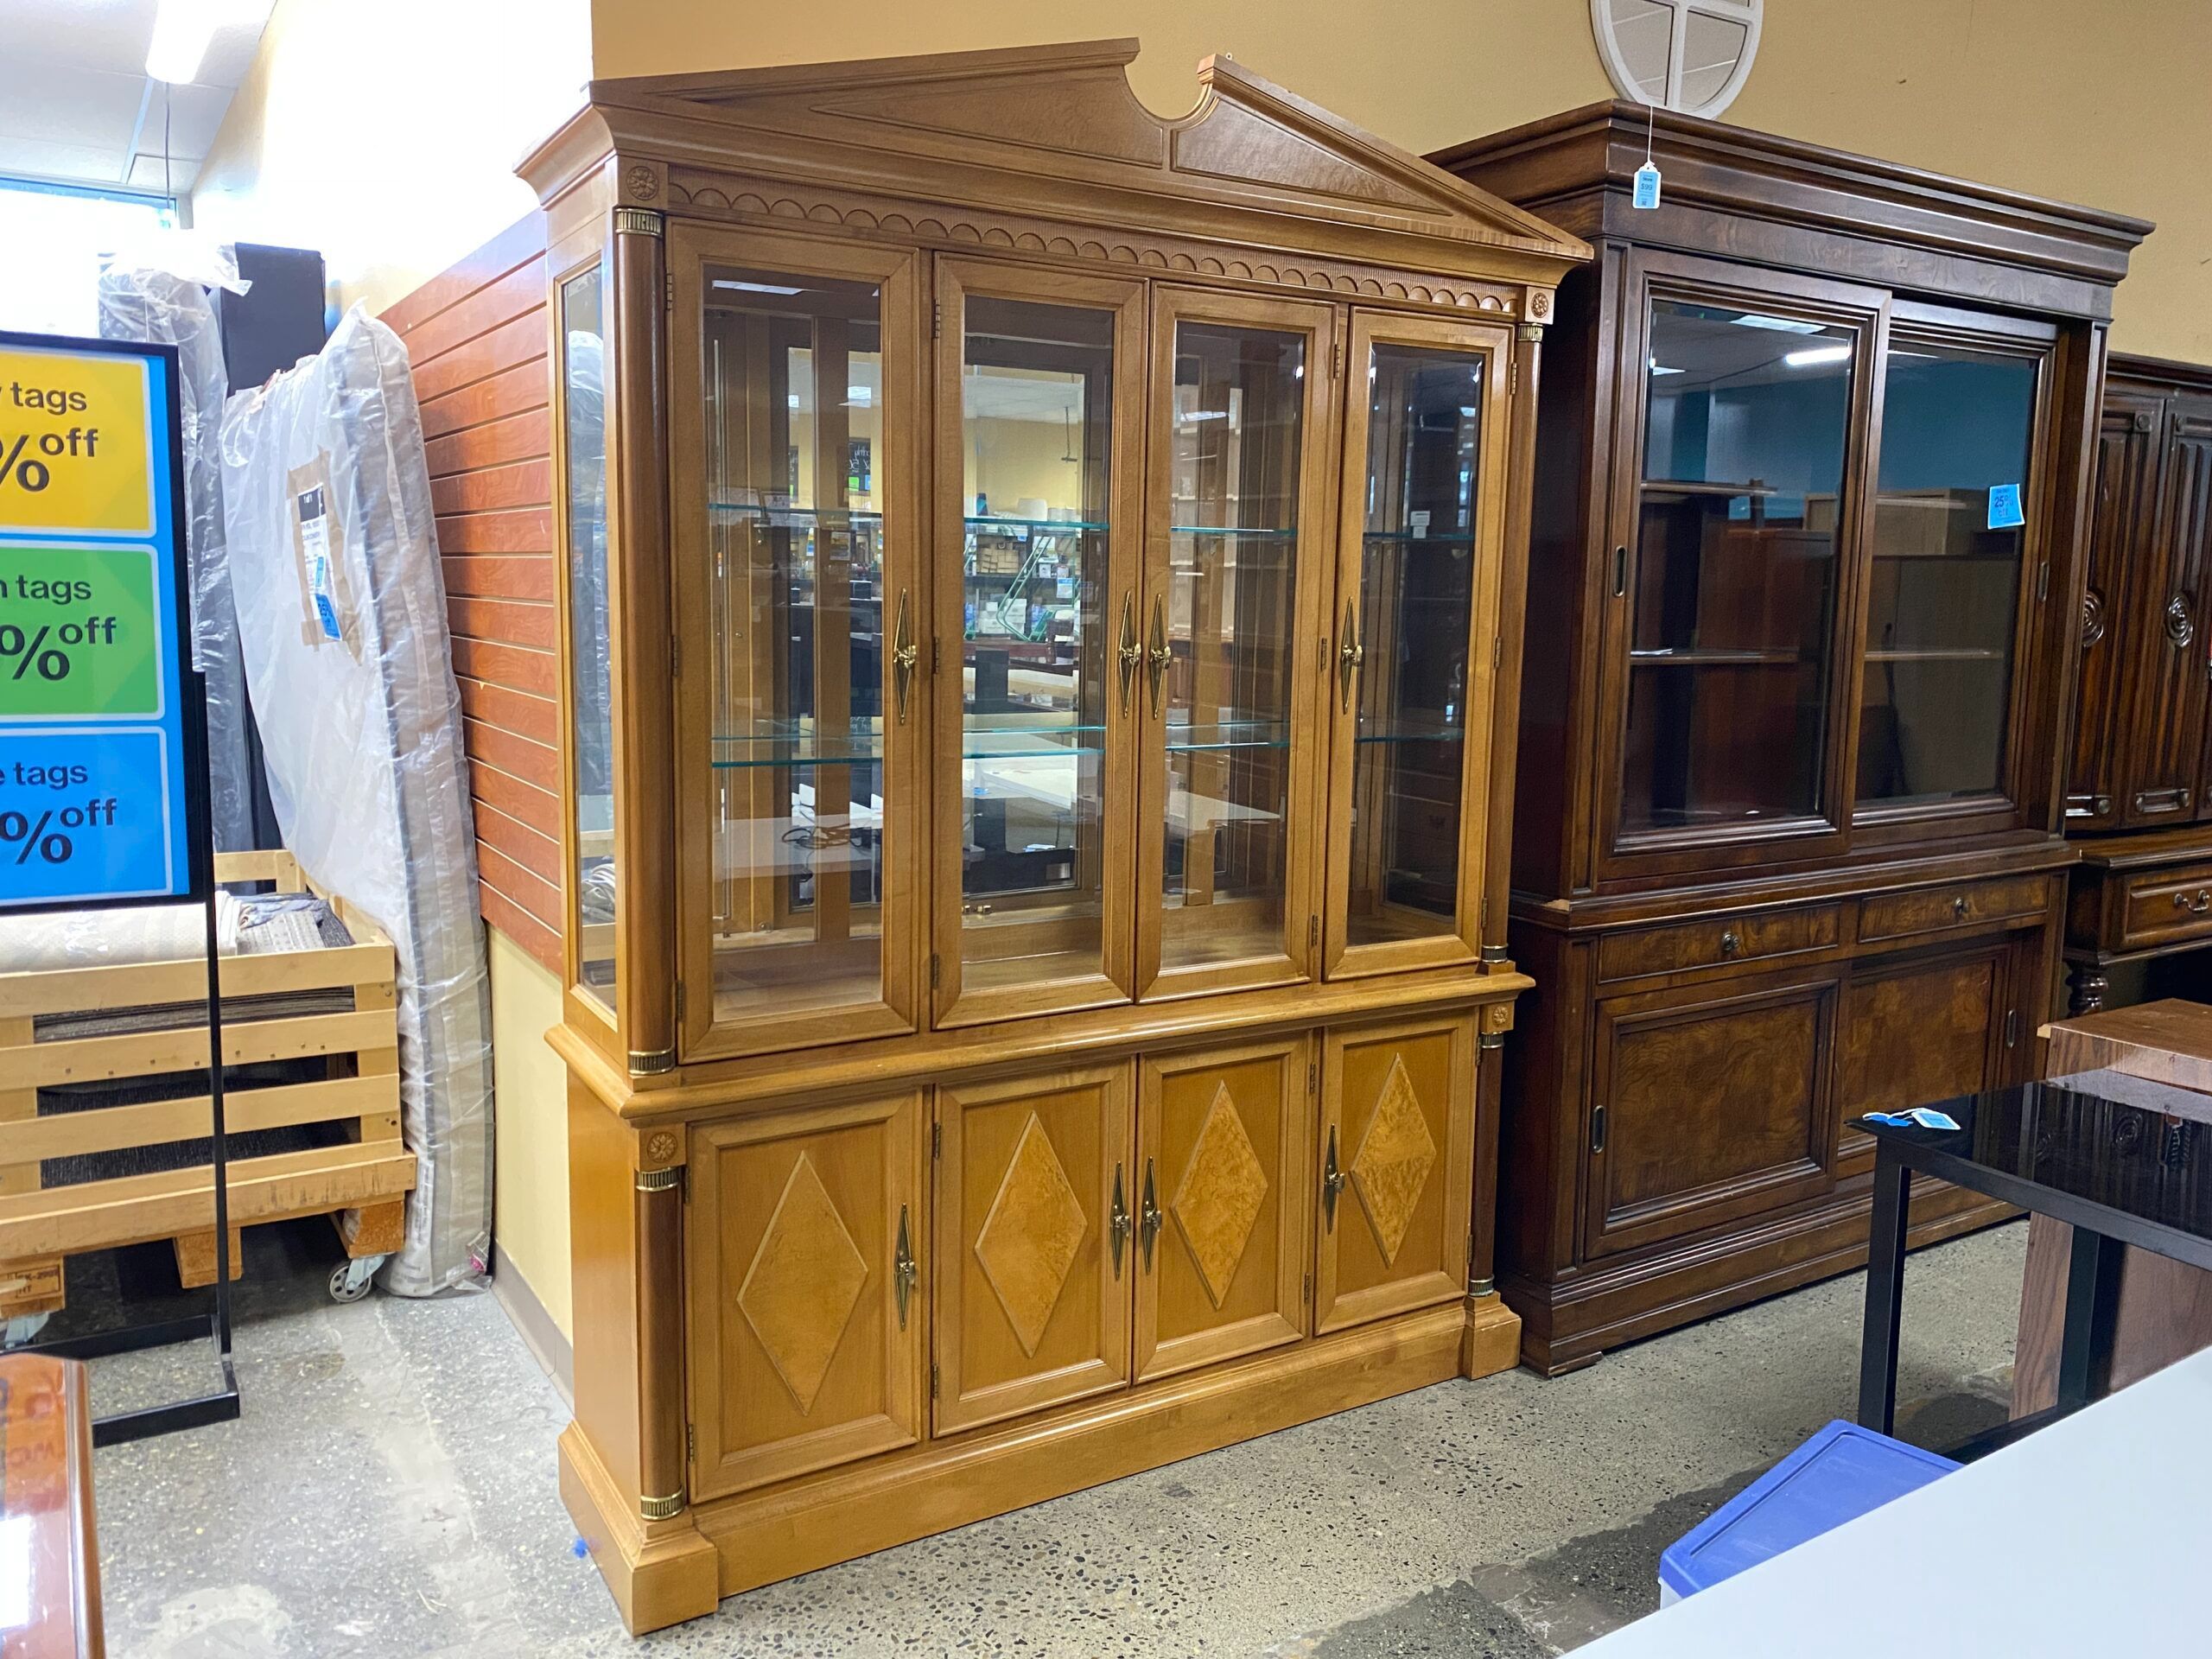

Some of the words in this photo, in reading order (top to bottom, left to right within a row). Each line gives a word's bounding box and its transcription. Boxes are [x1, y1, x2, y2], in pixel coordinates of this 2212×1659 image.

[10, 382, 87, 416] tags
[39, 427, 99, 458] off
[15, 575, 92, 606] tags
[58, 616, 117, 645] off
[12, 761, 89, 791] tags
[60, 798, 118, 828] off
